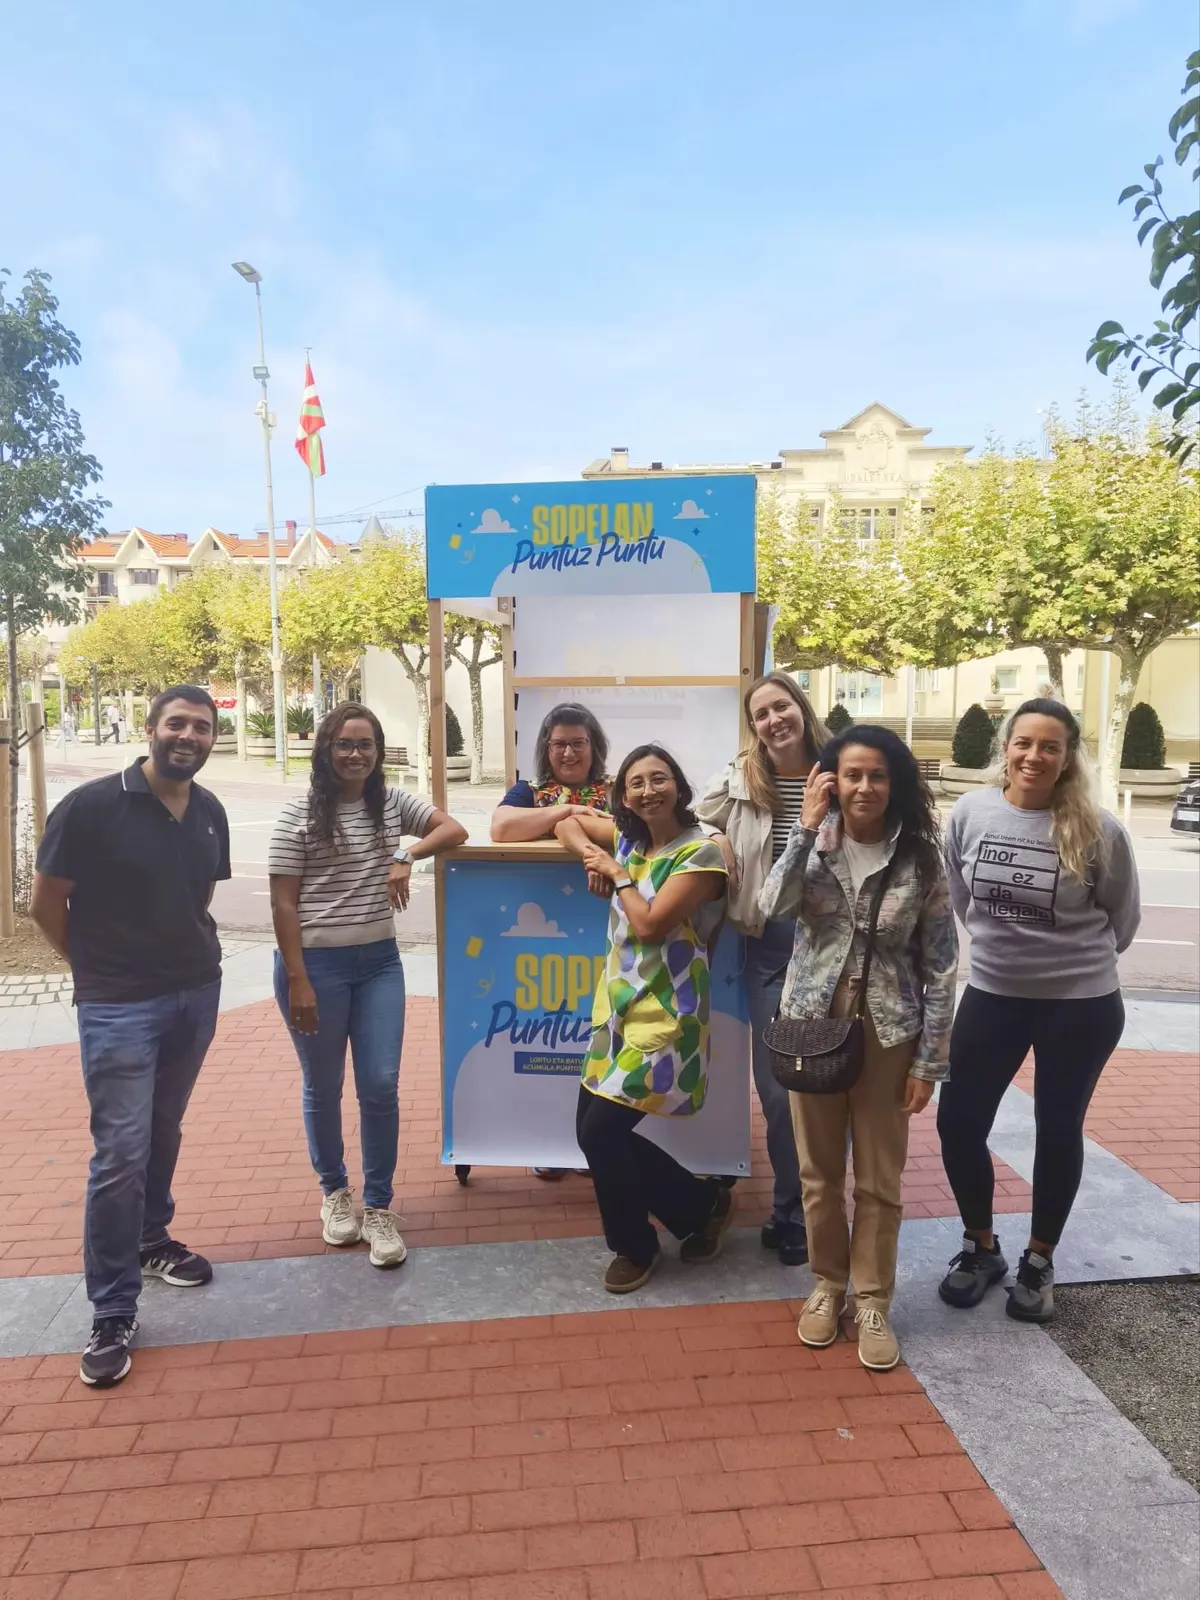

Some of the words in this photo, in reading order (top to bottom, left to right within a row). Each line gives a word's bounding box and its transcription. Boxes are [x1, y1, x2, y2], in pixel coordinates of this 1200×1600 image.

[532, 502, 653, 546] SOPELAN
[511, 536, 593, 574] Puntuz
[596, 528, 666, 567] Puntu
[982, 845, 1018, 864] inor
[1012, 872, 1035, 886] ez
[989, 885, 1012, 901] da
